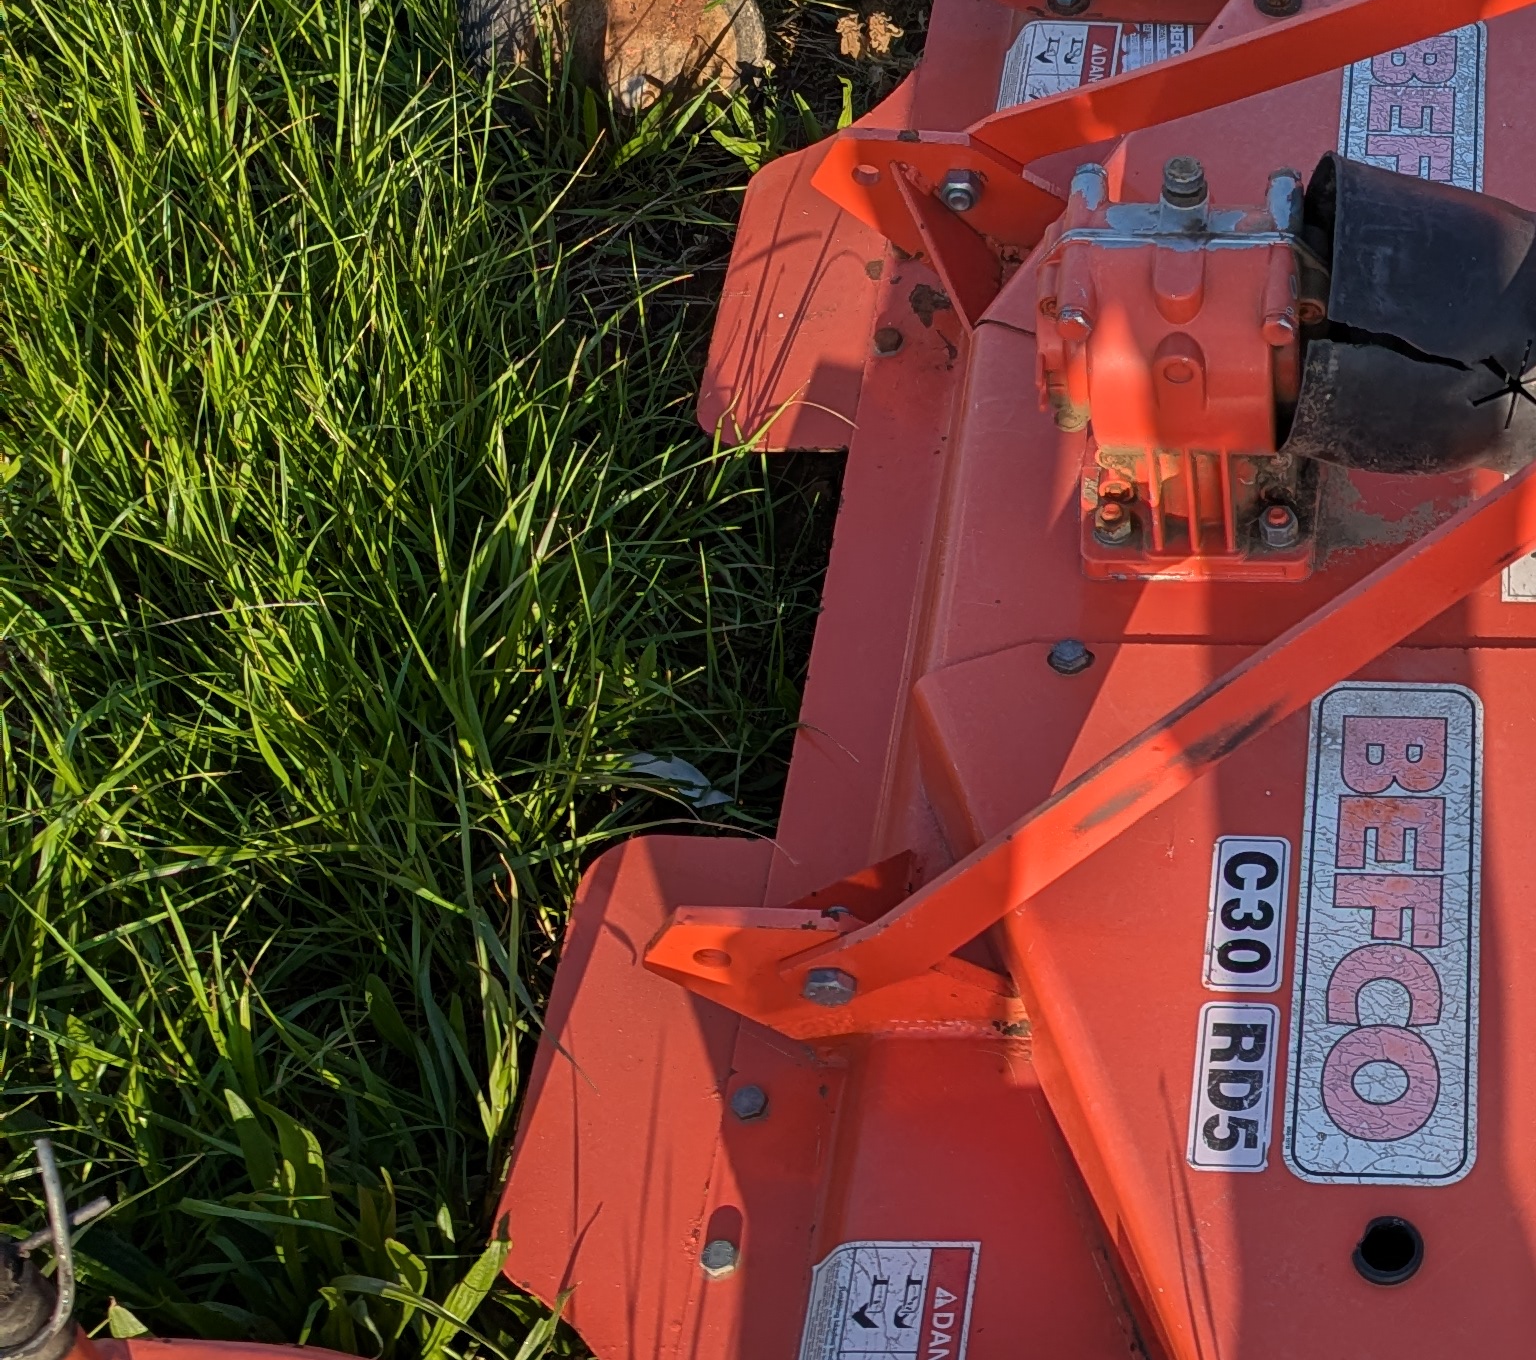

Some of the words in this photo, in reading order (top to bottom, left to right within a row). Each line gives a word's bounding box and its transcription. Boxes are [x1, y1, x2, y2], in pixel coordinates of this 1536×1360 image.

[1366, 35, 1458, 183] BEF
[1216, 851, 1279, 976] C30
[1321, 714, 1449, 1143] BEFCO
[1202, 1022, 1269, 1152] RD5
